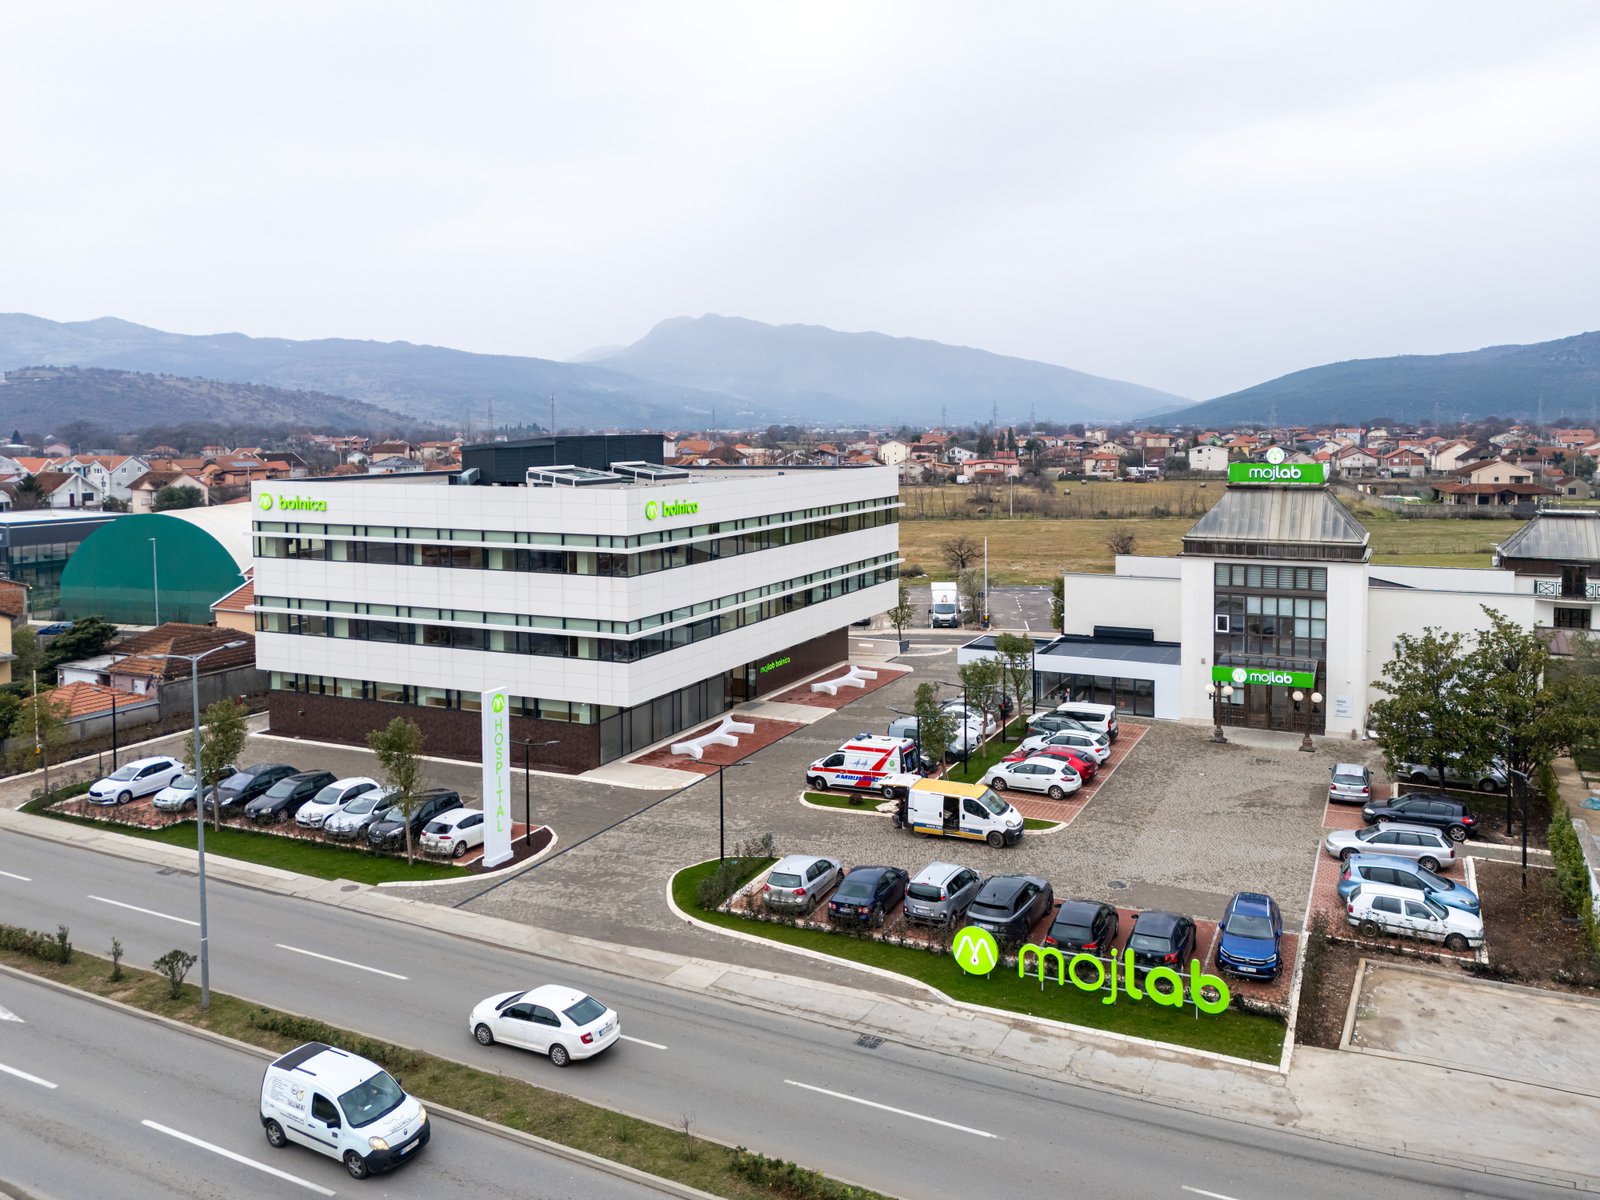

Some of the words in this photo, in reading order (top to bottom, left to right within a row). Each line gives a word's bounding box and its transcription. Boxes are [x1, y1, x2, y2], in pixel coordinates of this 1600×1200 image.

[1249, 465, 1302, 481] mojlab
[279, 495, 327, 512] bolnica
[662, 499, 699, 517] bolnica
[1250, 671, 1293, 685] mojlab
[494, 717, 504, 833] HOSPITAL
[1018, 943, 1231, 1014] mojlab
